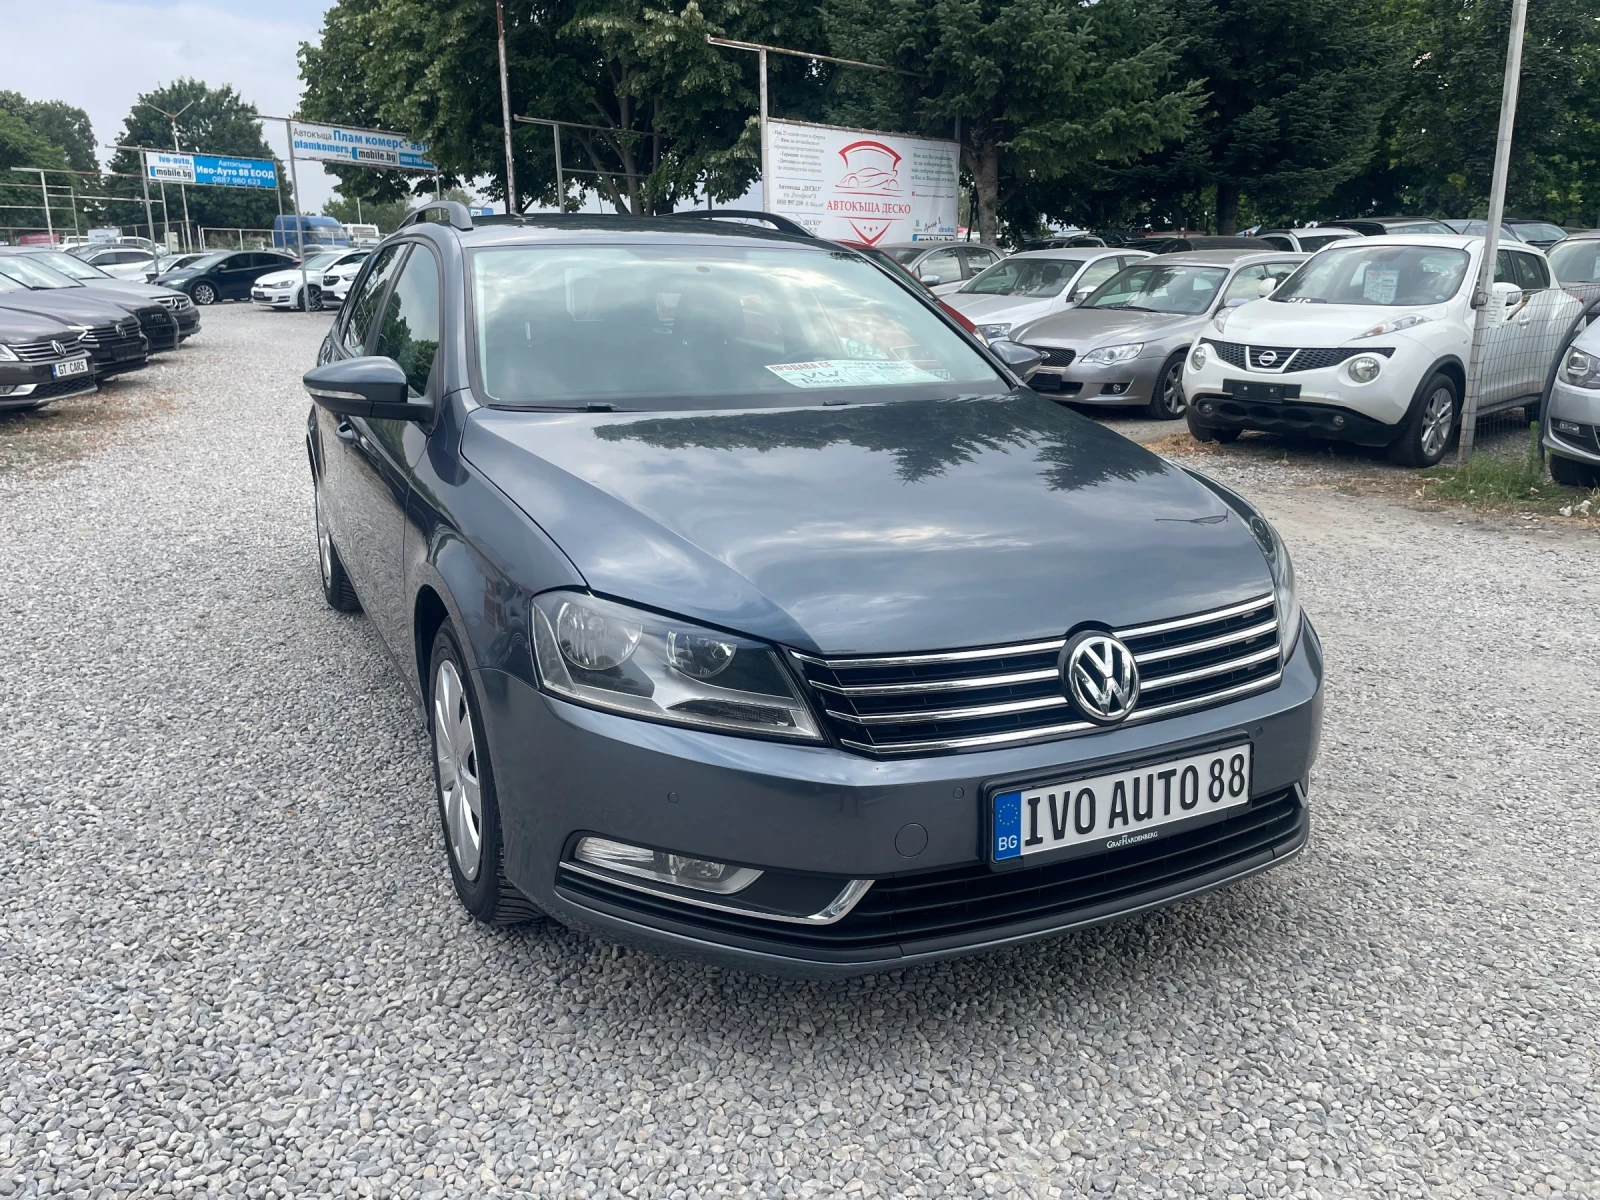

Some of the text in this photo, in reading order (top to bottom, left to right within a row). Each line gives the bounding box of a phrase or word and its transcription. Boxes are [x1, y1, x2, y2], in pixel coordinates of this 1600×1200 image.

[293, 127, 332, 141] Автокъща
[333, 129, 363, 144] Плам
[365, 135, 404, 150] комерс
[358, 149, 396, 163] mobile.bg
[218, 159, 252, 169] Автокъща
[156, 168, 192, 179] mobile.bg
[196, 165, 275, 180] Иво-Ауто 88 ЕООД
[232, 177, 246, 185] 980
[247, 177, 261, 186] 623
[826, 200, 881, 215] АВТОКЪЩА
[881, 202, 912, 215] ДЕСКО
[58, 361, 85, 375] GT CARS
[769, 362, 820, 372] ПРОДАВА
[818, 361, 835, 369] СЕ
[1024, 753, 1246, 847] IVO AUTO 88
[998, 834, 1018, 851] BG
